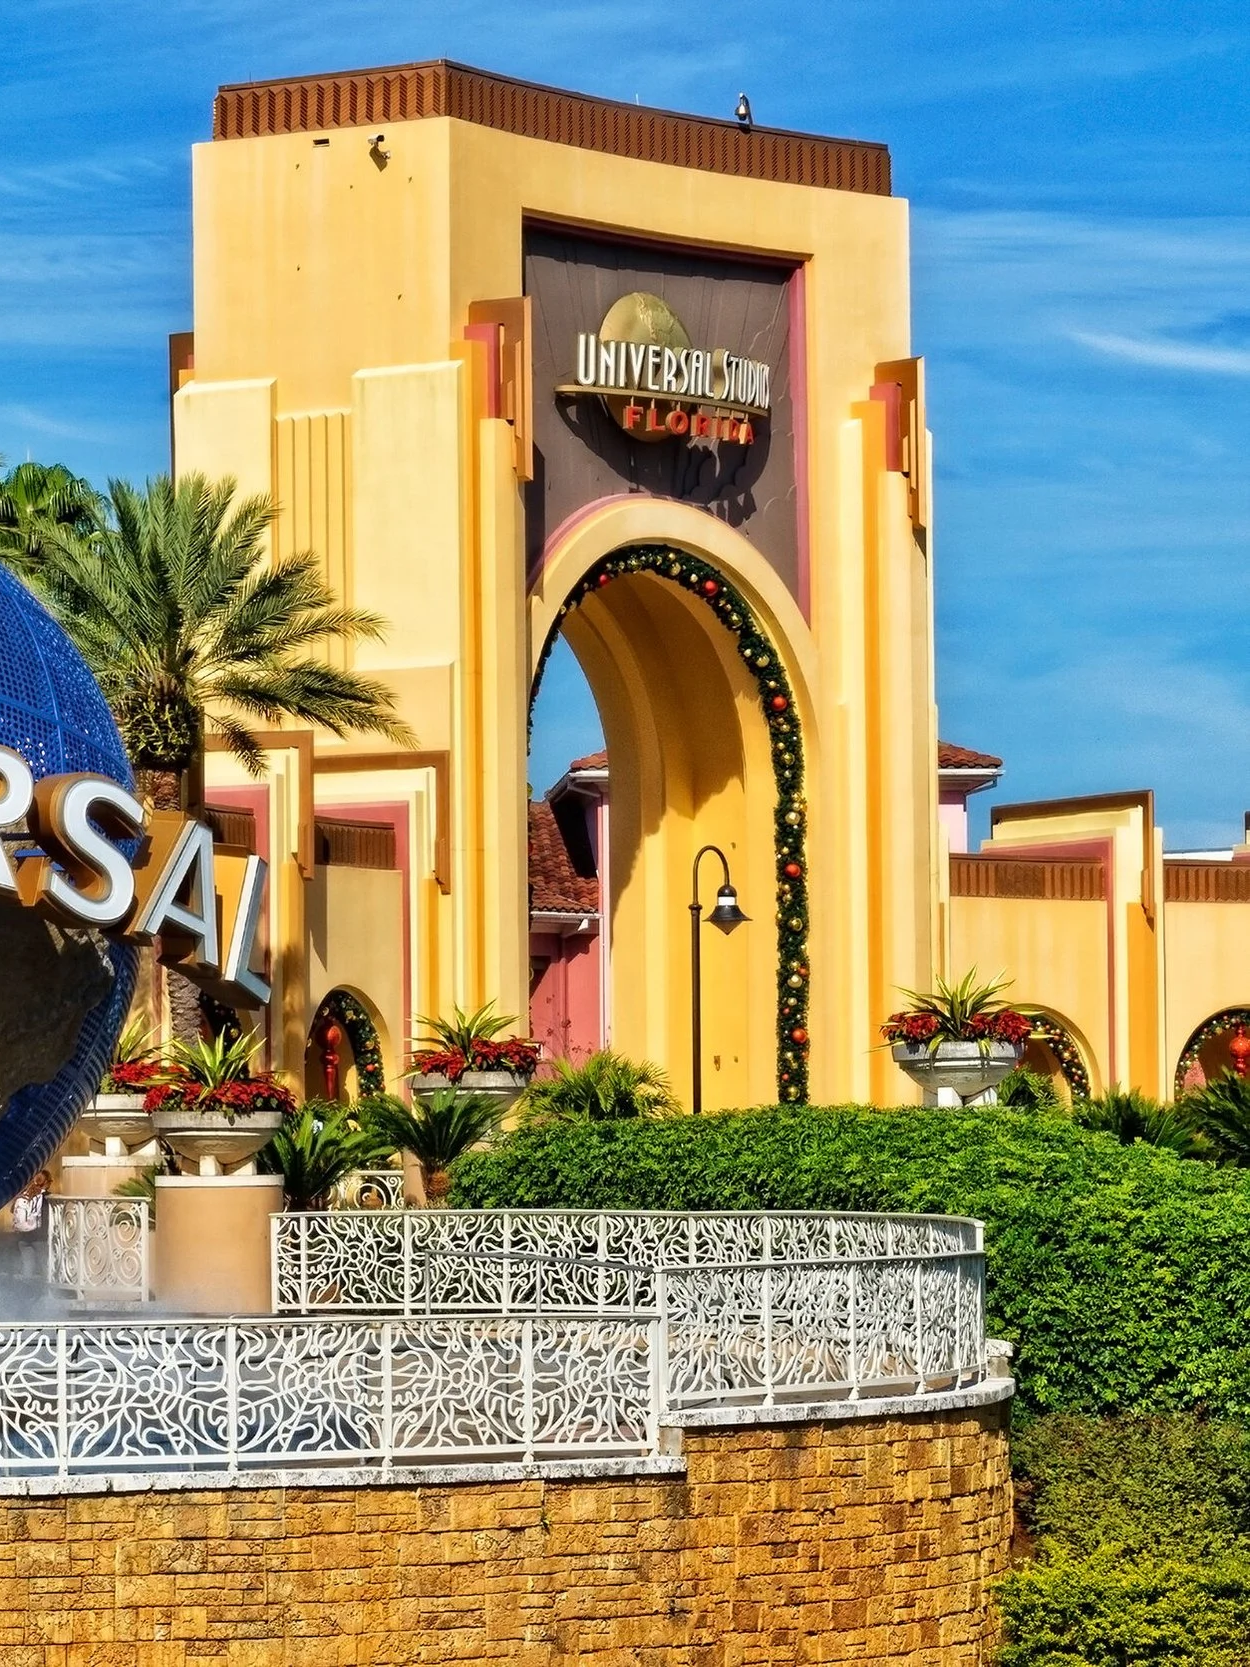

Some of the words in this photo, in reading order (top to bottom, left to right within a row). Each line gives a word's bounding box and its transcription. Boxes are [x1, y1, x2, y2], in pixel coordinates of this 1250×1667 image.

[577, 332, 715, 399] UNIVERSAL
[719, 350, 770, 409] STUDIOS
[623, 405, 755, 445] FLORIDA
